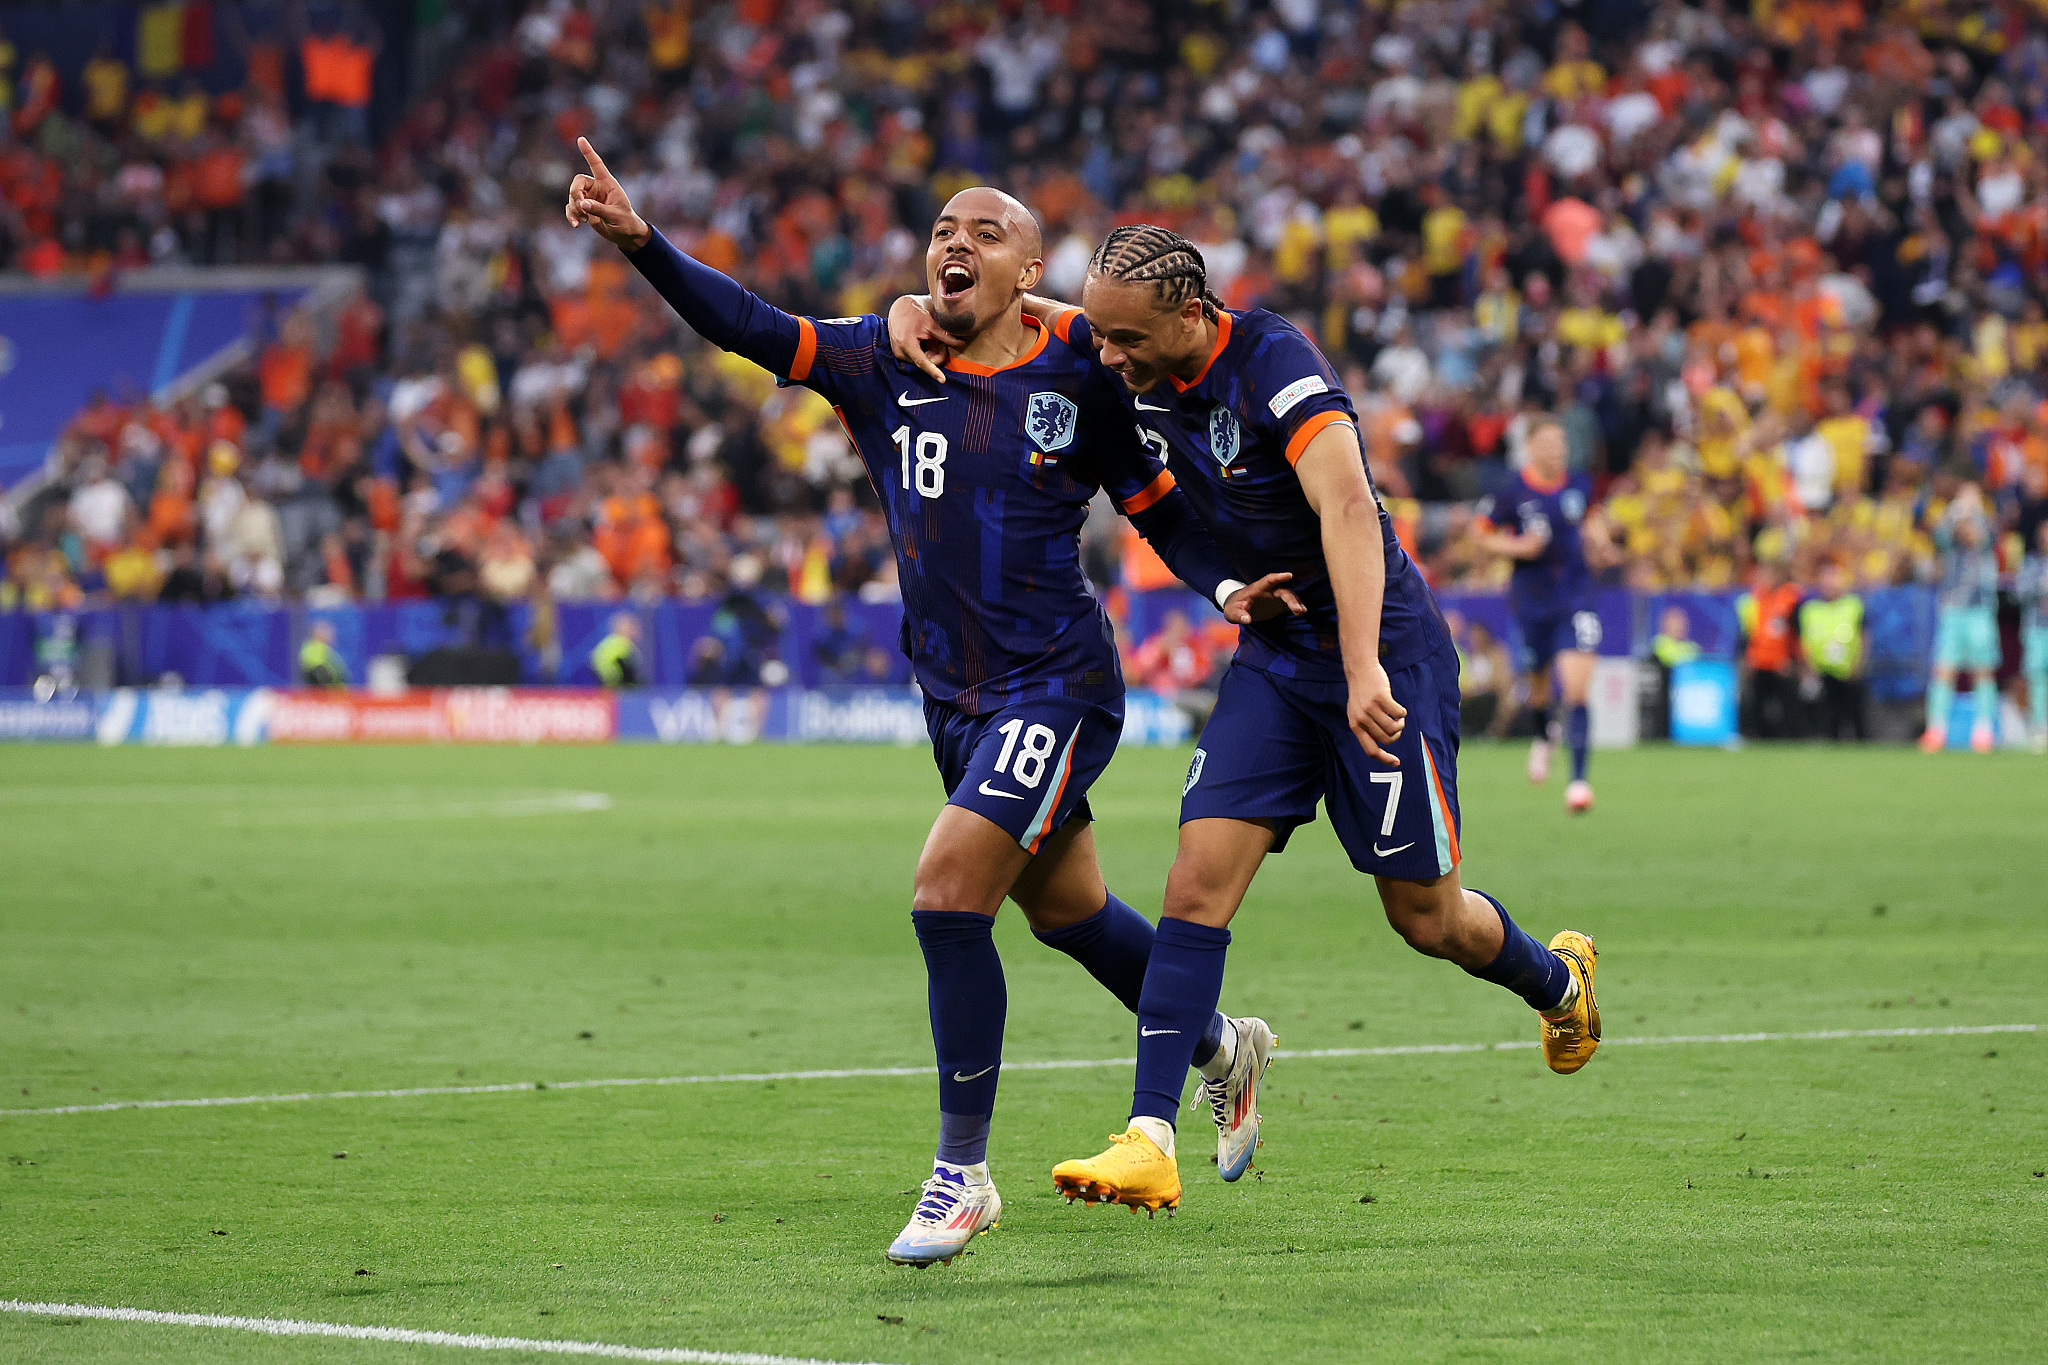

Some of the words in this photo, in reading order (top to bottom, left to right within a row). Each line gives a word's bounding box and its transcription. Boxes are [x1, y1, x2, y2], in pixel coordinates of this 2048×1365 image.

[1272, 380, 1324, 413] FOUNDATION
[891, 425, 949, 499] 18
[994, 718, 1057, 789] 18
[1369, 771, 1403, 837] 7
[965, 1195, 991, 1207] F50
